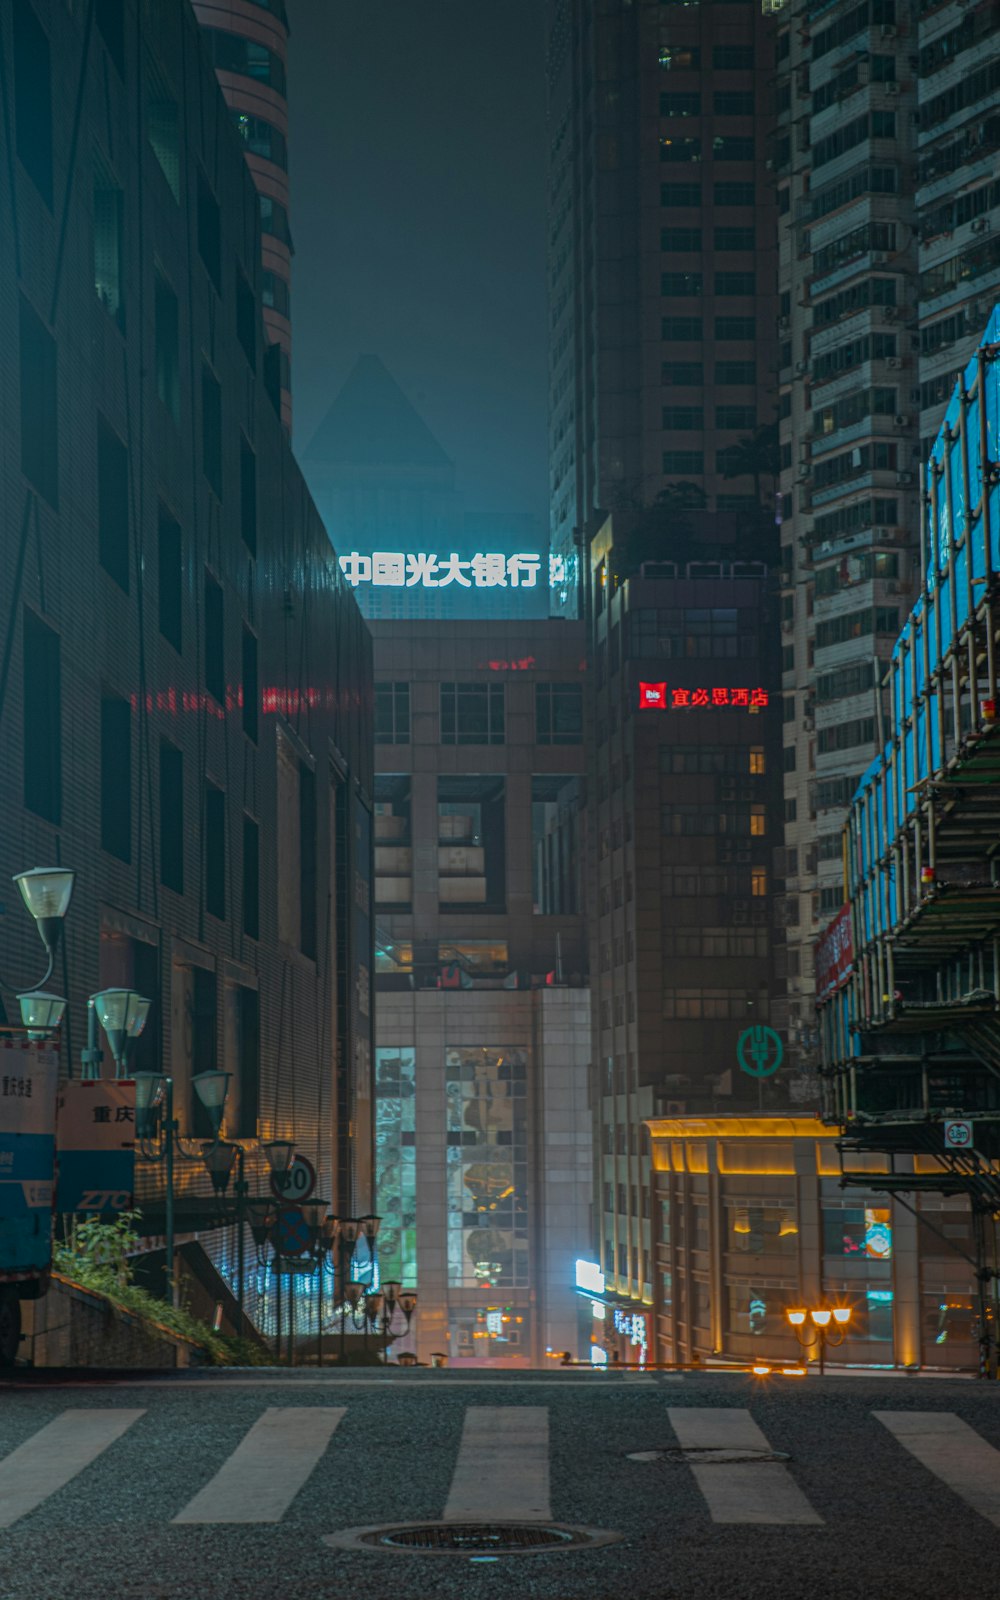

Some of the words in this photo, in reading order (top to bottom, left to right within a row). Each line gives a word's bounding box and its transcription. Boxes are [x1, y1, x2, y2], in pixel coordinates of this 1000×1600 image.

[339, 552, 541, 588] 中国光大银行
[645, 689, 661, 700] ibis
[671, 687, 769, 706] 宜必思酒店
[92, 1105, 135, 1123] 重庆
